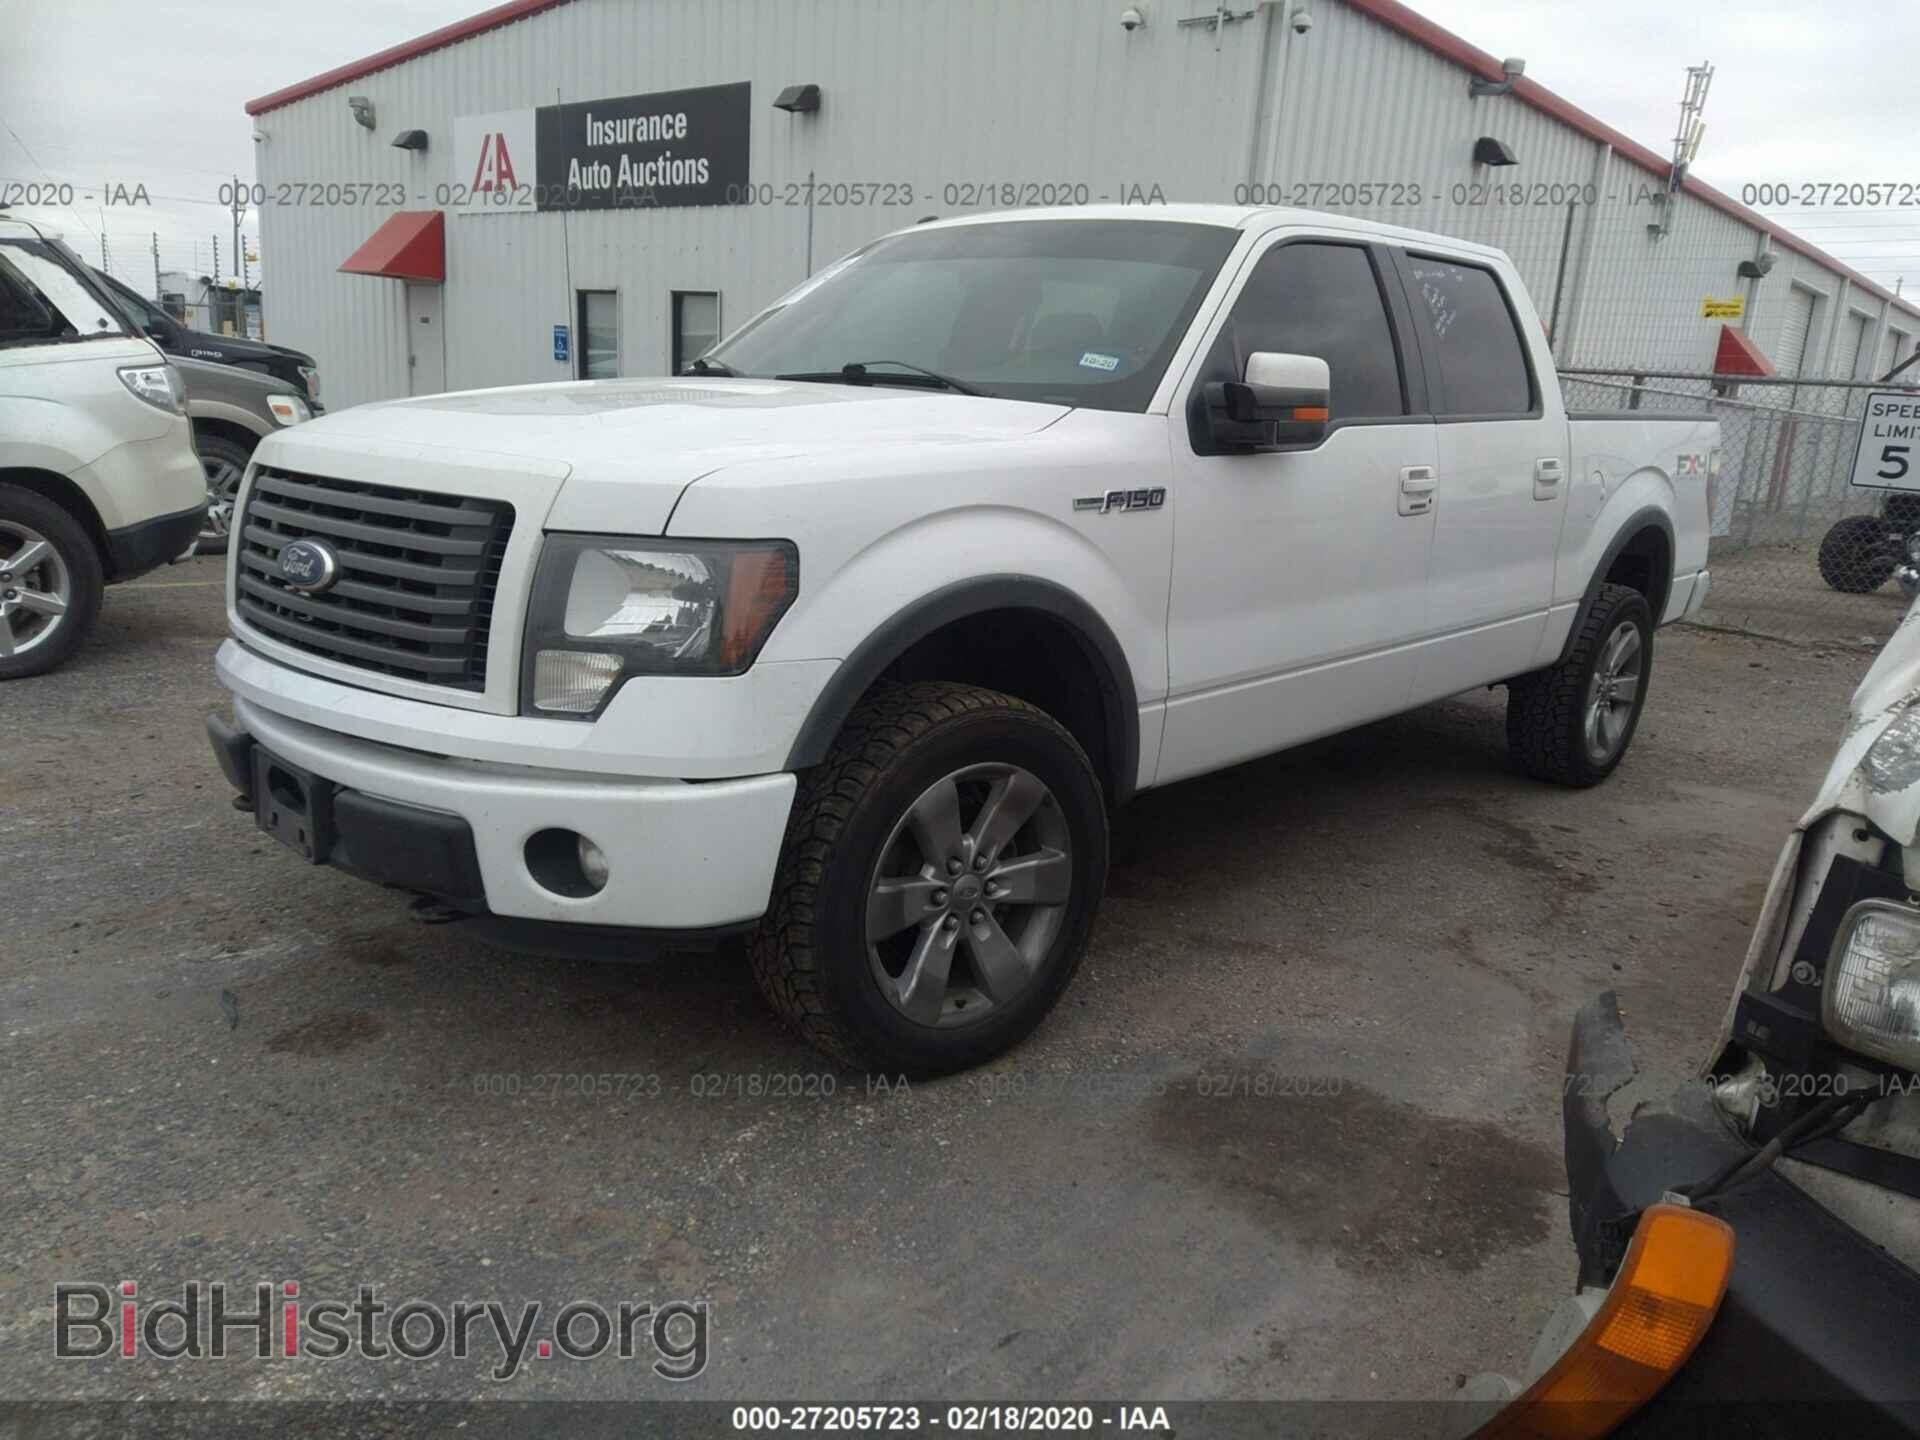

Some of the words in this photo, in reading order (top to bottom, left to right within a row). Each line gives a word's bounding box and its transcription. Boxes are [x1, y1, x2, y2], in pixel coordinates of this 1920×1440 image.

[586, 112, 688, 147] Insurance
[567, 157, 612, 191] Auto
[616, 151, 710, 189] Auctions
[1876, 444, 1911, 480] 5
[282, 546, 315, 577] Ford
